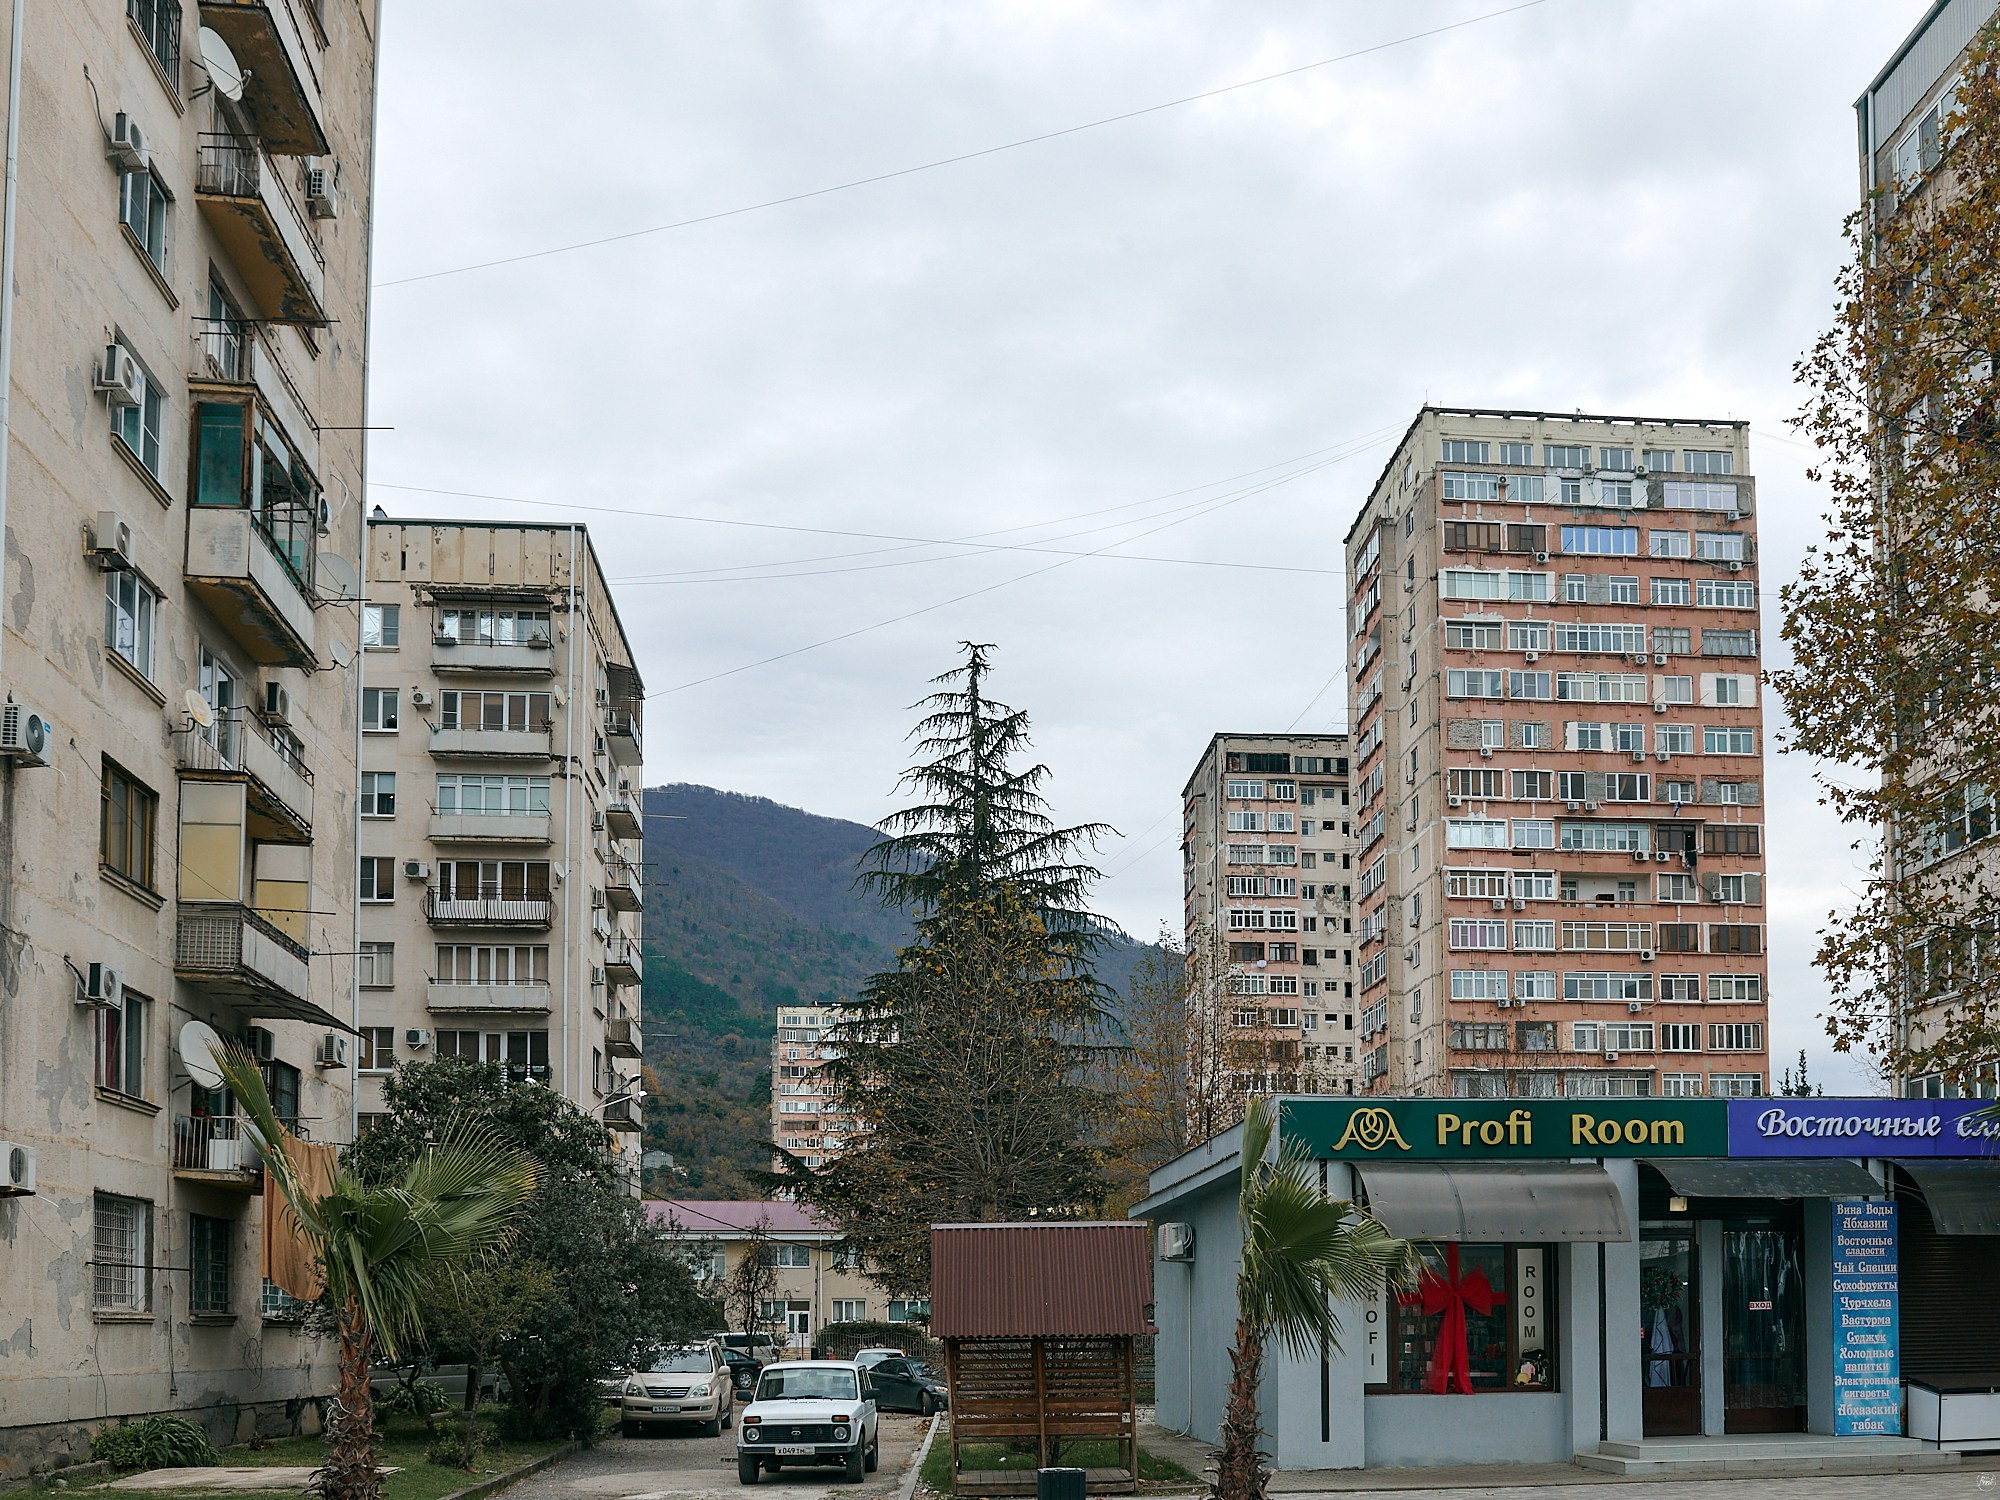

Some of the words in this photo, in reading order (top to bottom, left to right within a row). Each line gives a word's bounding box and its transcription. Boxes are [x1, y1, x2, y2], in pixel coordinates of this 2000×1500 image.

[1437, 1109, 1532, 1145] Profi
[1571, 1113, 1685, 1145] Room
[1757, 1108, 1942, 1137] Восточные
[1837, 1204, 1862, 1215] Вина
[1866, 1204, 1893, 1216] Воды
[1843, 1217, 1888, 1229] Абхазии
[1837, 1235, 1893, 1246] Восточные
[1834, 1262, 1855, 1273] Чай
[1858, 1261, 1897, 1273] Специи
[1833, 1280, 1898, 1292] Сухофрукты
[1523, 1265, 1536, 1338] ROOM
[1840, 1297, 1892, 1309] Чурчхела
[1842, 1314, 1891, 1326] Бастурма
[1847, 1331, 1887, 1343] Суджук
[1840, 1347, 1894, 1359] Холодные
[1845, 1363, 1889, 1371] напитки
[1835, 1376, 1899, 1386] Электронные
[1844, 1390, 1890, 1398] сигареты
[1838, 1403, 1898, 1416] Абхазский
[1852, 1418, 1884, 1430] табак
